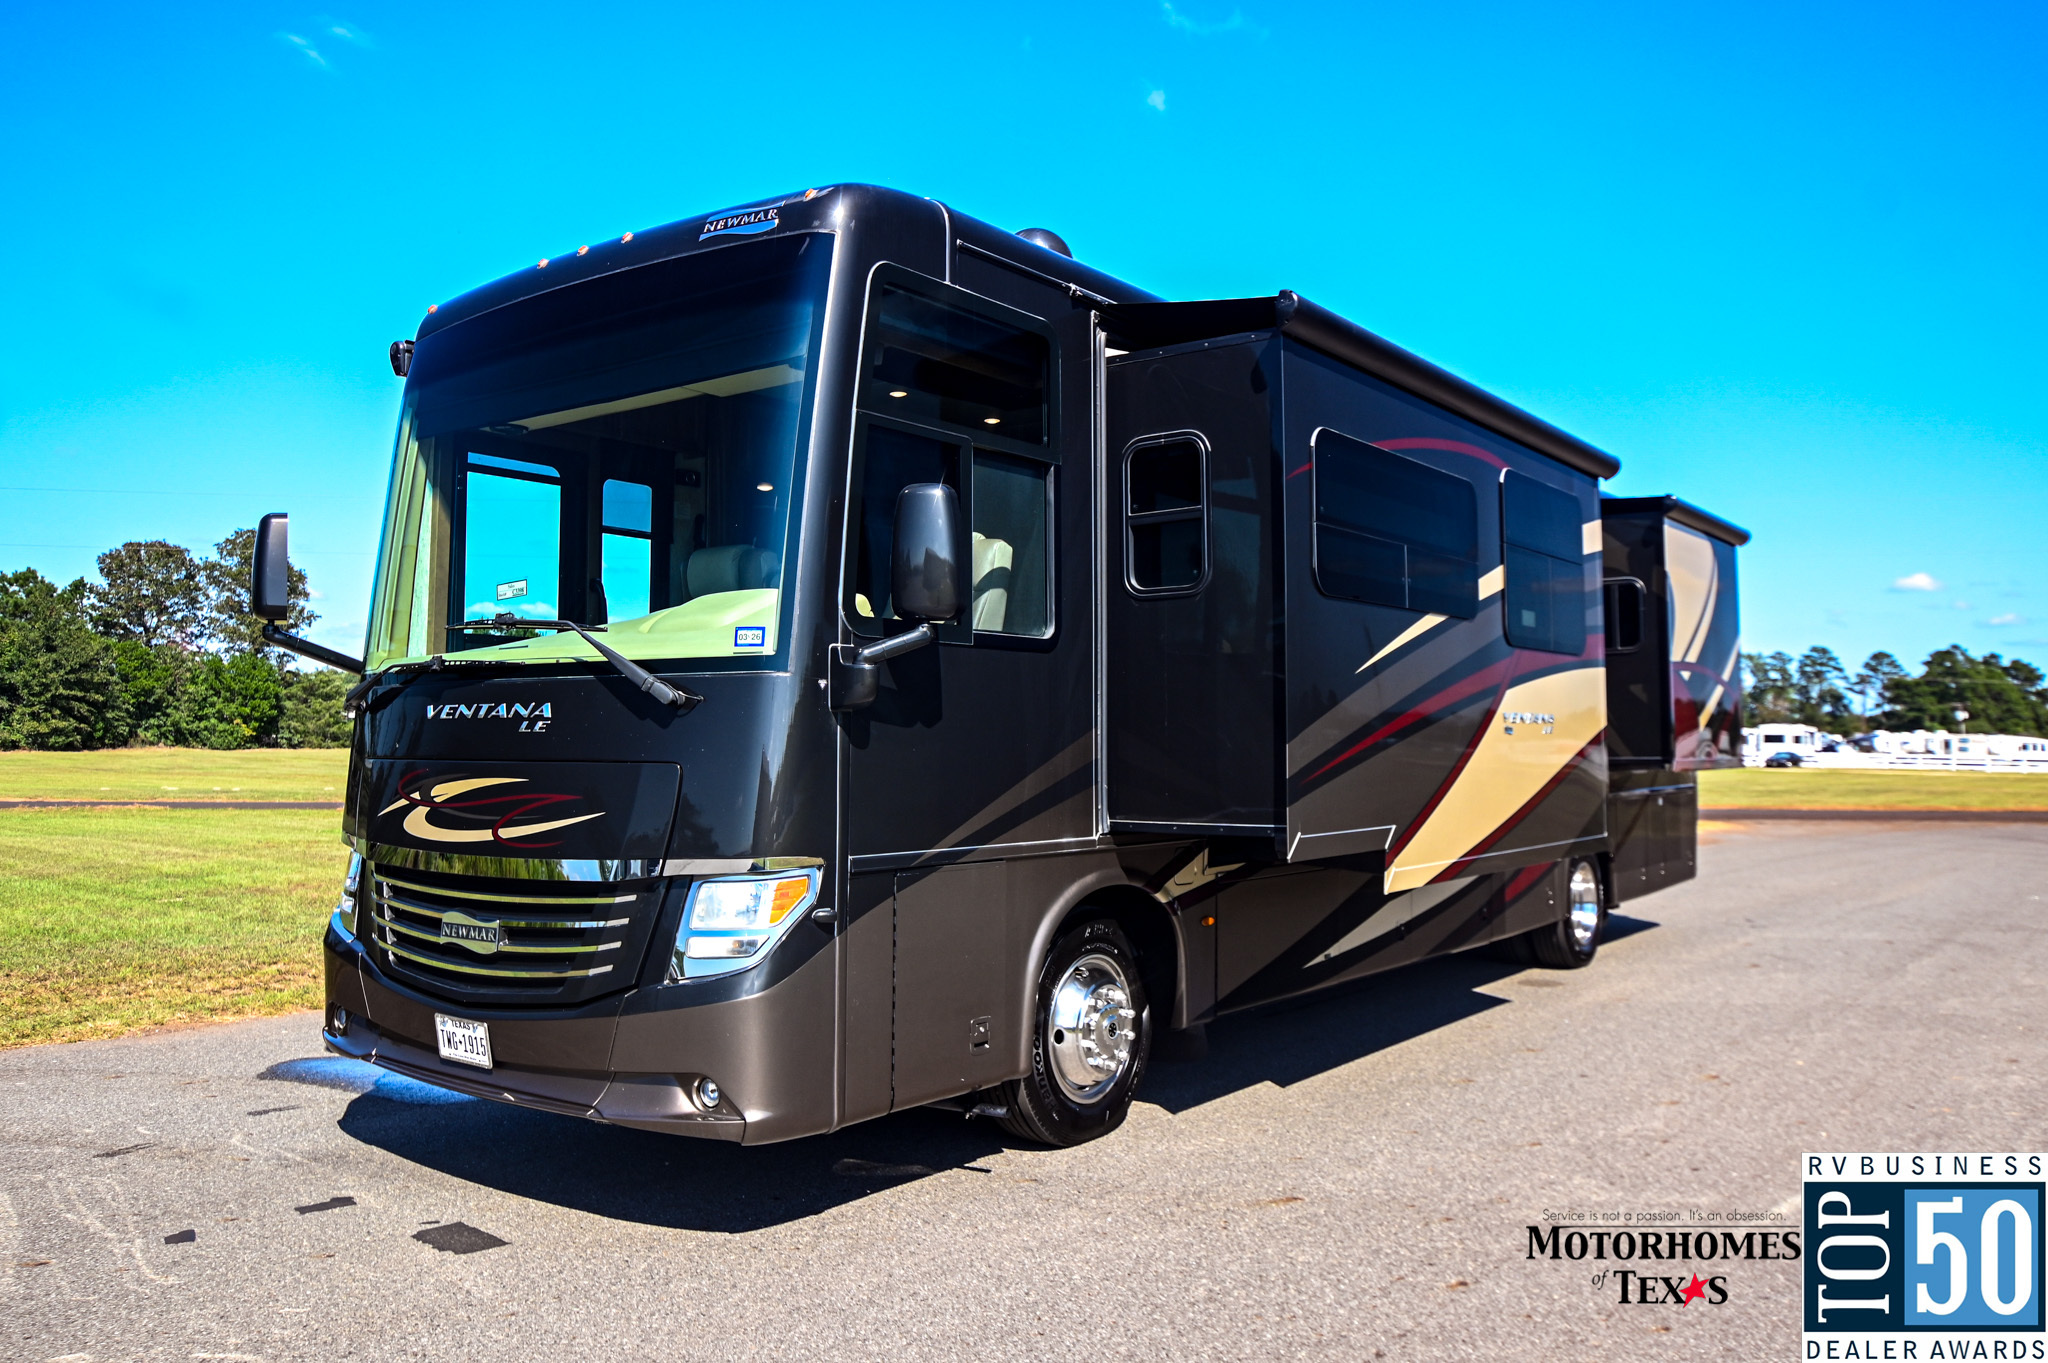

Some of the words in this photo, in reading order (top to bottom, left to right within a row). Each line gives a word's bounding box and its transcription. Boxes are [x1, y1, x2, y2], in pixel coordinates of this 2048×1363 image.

[703, 208, 779, 233] NEWMAR
[426, 702, 552, 720] VENTANA
[518, 720, 551, 732] LE
[442, 923, 497, 942] NEWMAR
